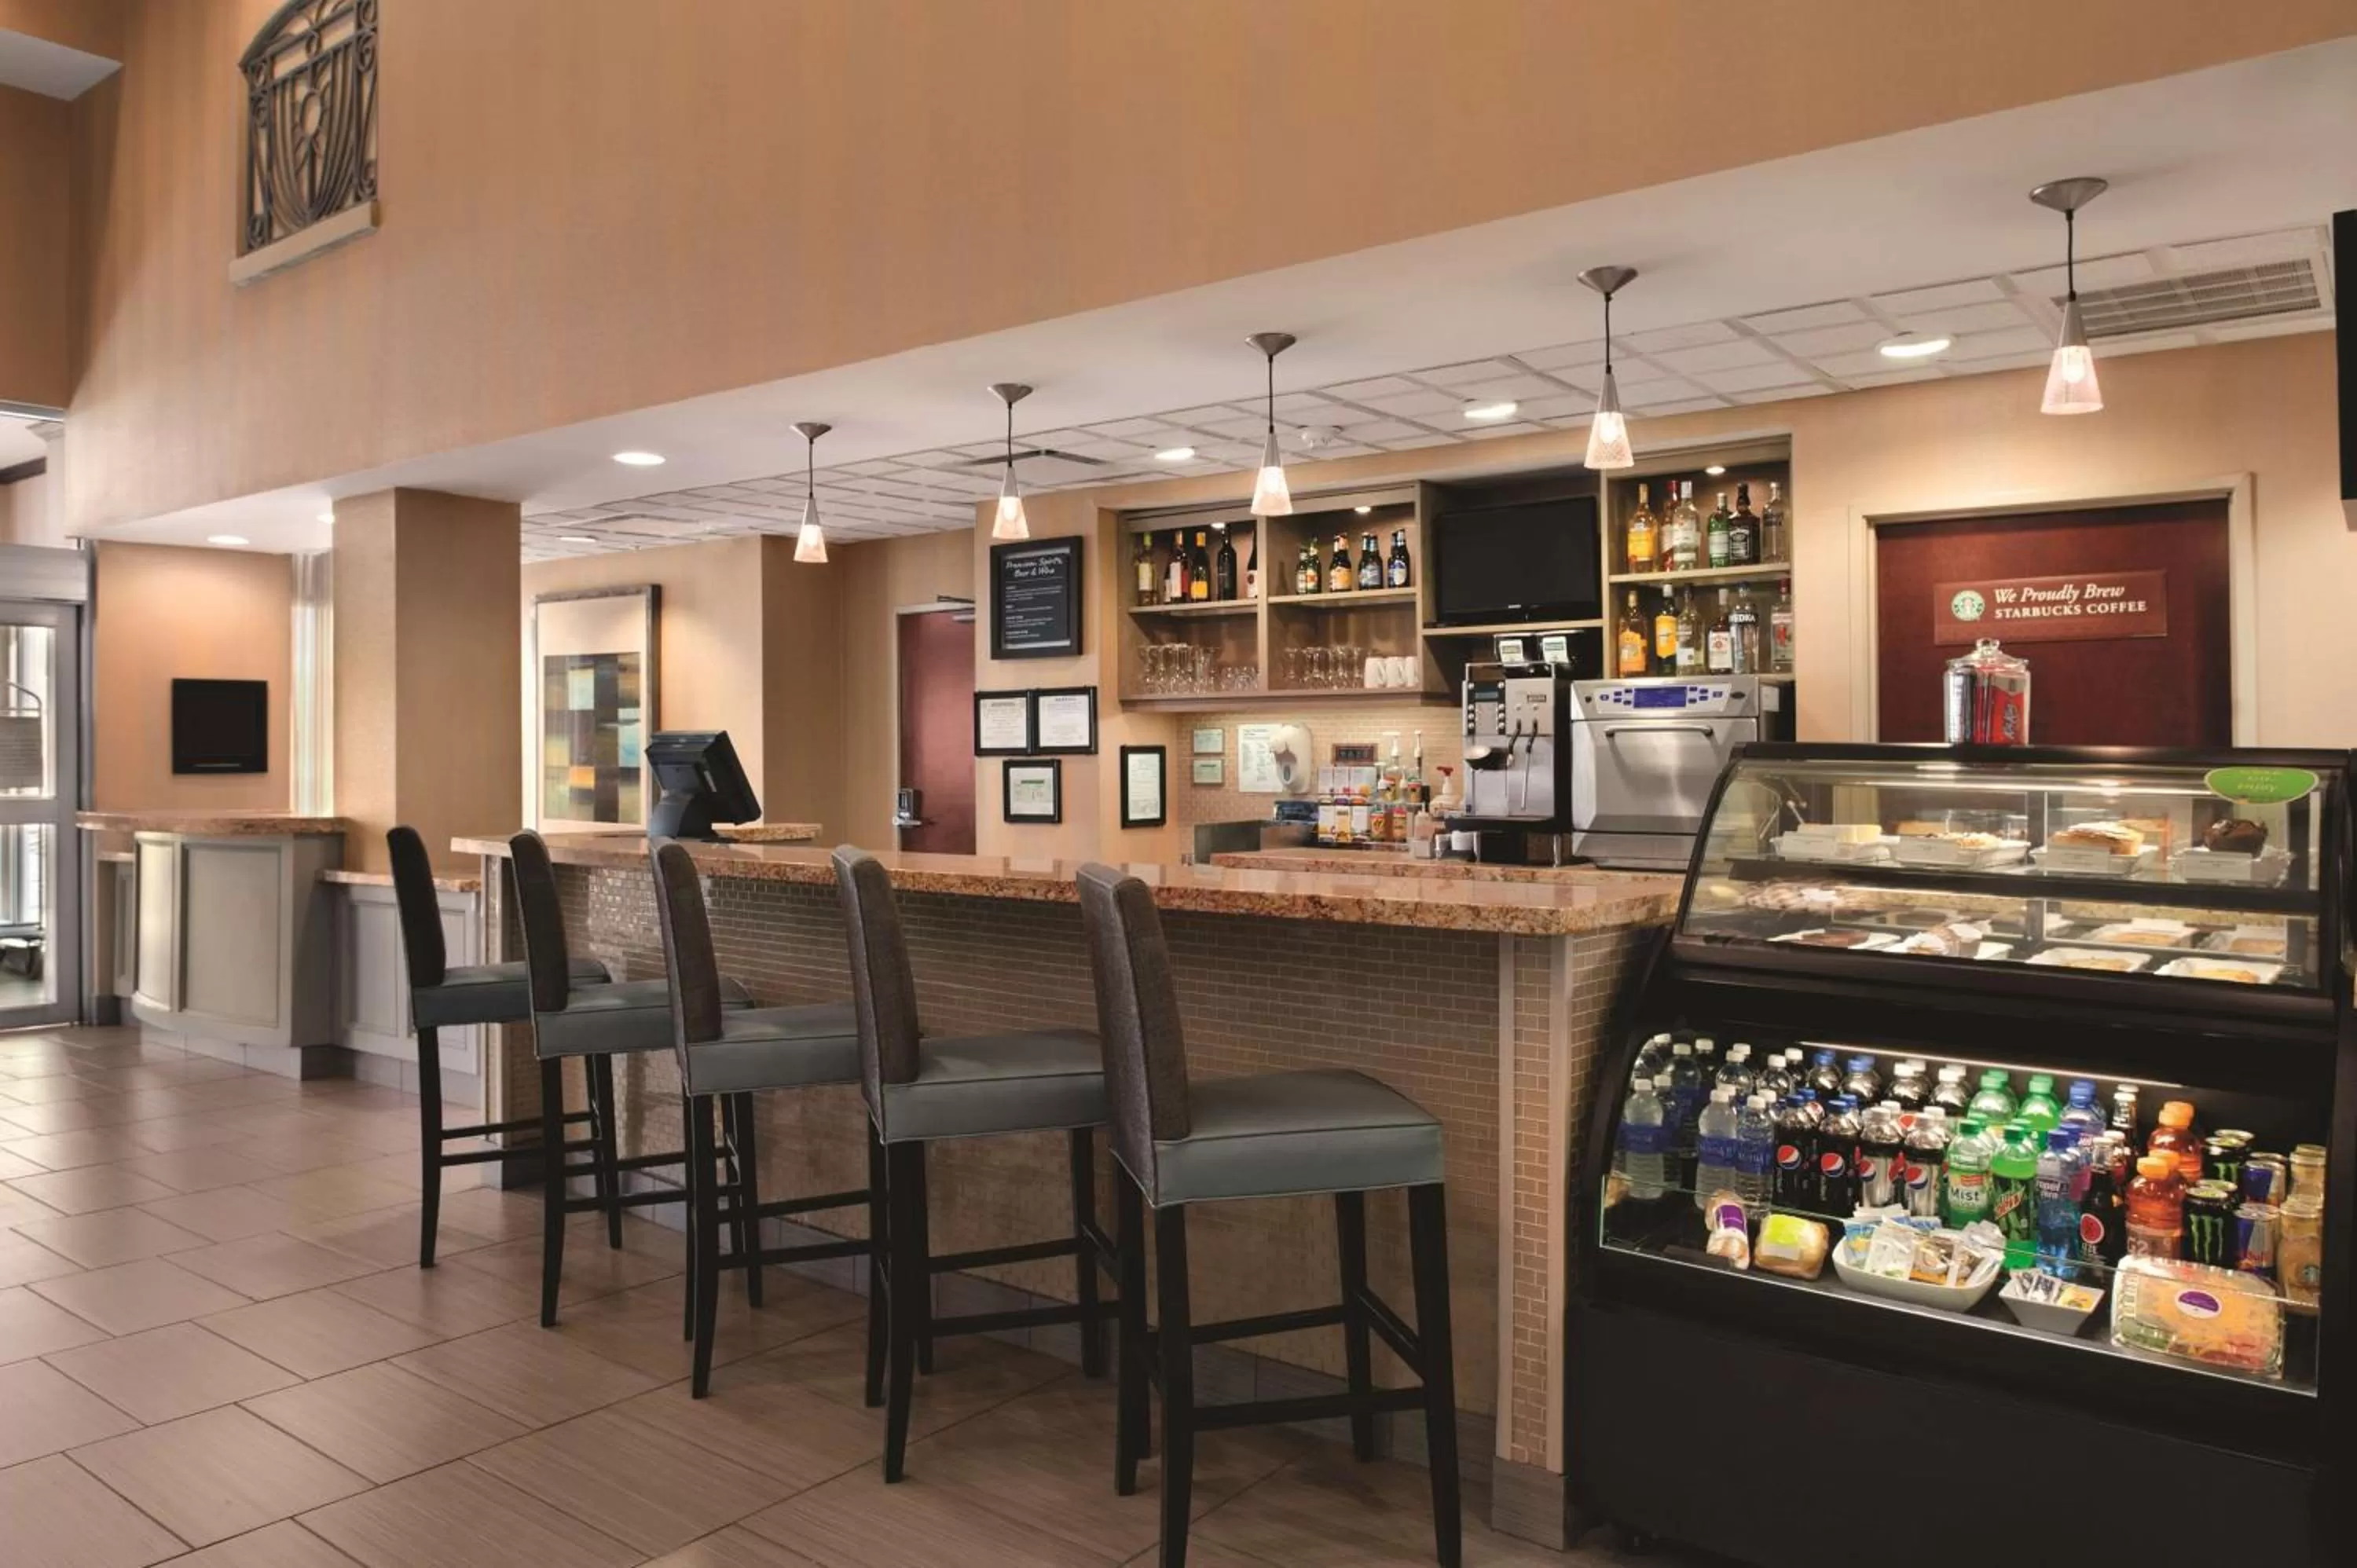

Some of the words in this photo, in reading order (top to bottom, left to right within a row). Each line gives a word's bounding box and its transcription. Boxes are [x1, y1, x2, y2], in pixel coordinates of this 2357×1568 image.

[1994, 588, 2017, 603] We
[2020, 584, 2080, 604] Proudly
[2084, 583, 2125, 599] Brew
[1993, 605, 2081, 619] STARBUCKS
[2086, 601, 2146, 614] COFFEE
[1951, 1187, 1980, 1201] Mist
